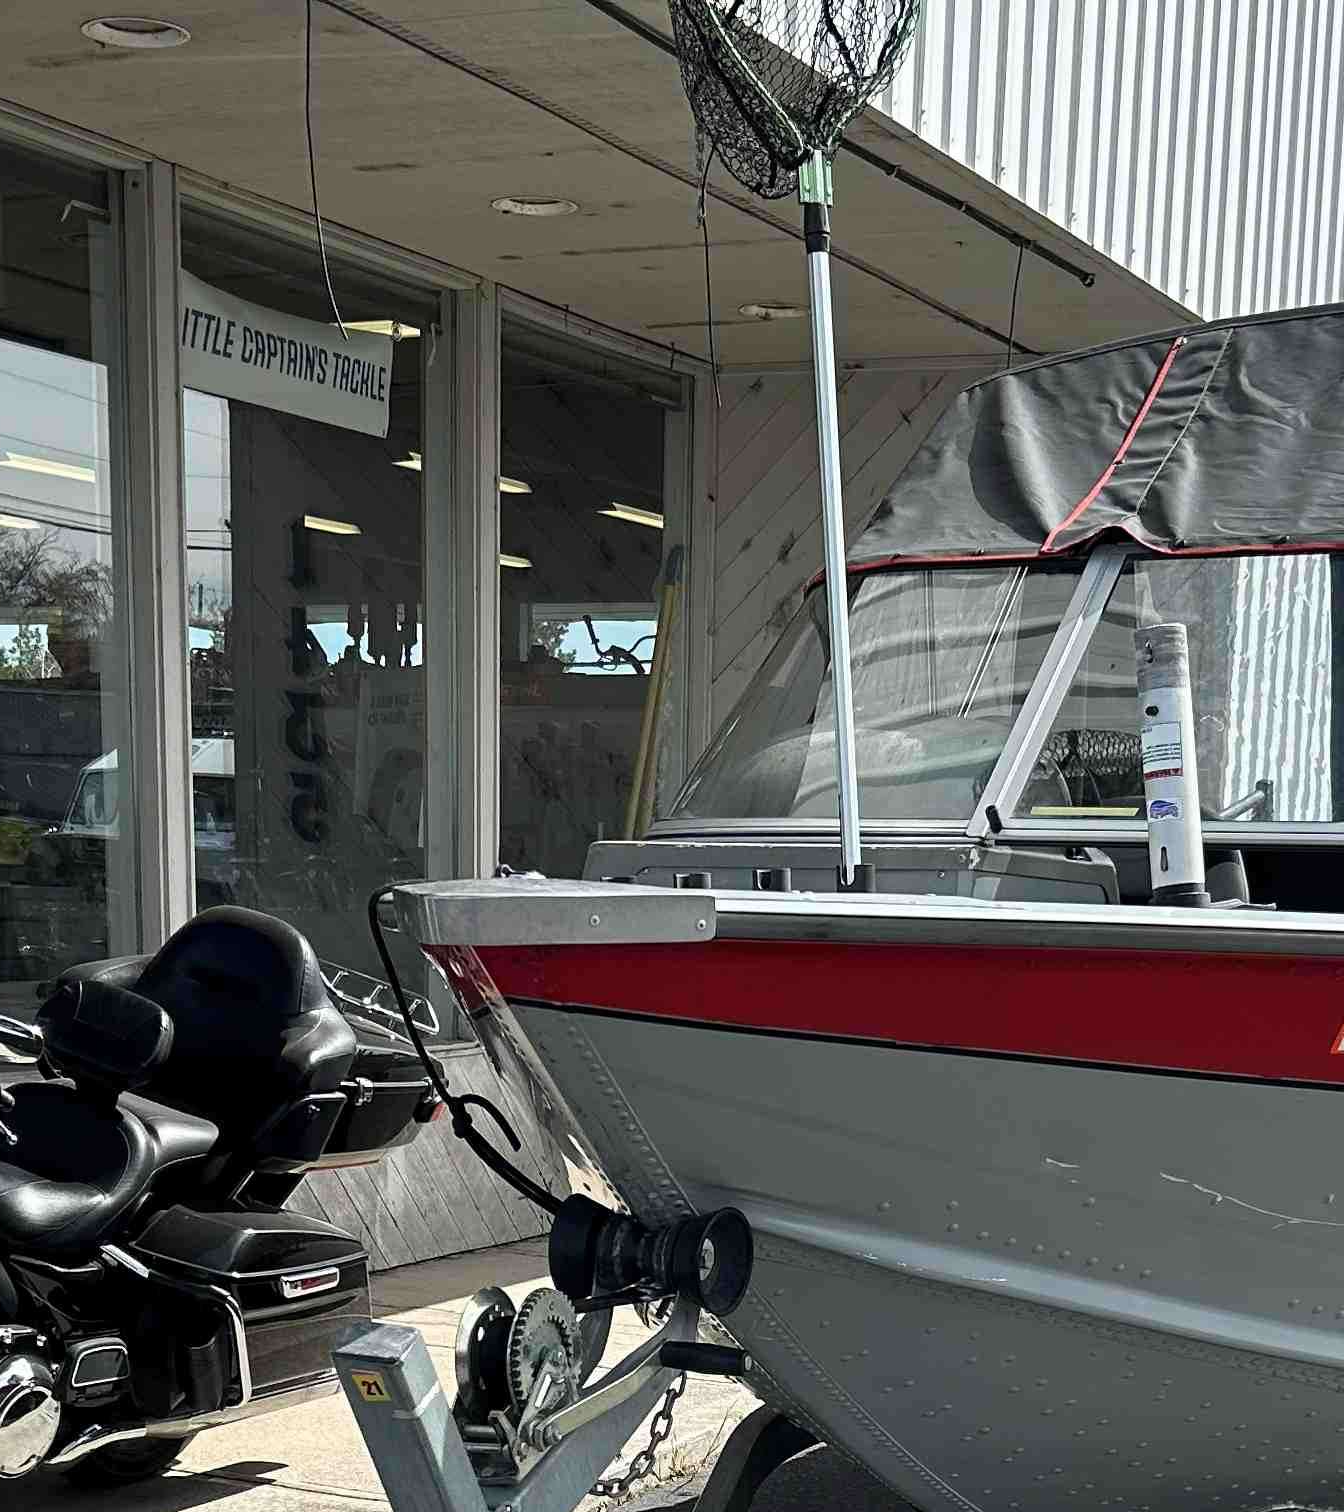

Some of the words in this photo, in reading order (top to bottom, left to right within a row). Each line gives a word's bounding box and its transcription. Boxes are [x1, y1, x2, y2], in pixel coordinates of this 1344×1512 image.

[182, 307, 236, 359] ITTLE
[241, 325, 328, 385] CAPTAIN'S
[332, 351, 388, 403] TACKLE
[362, 1380, 384, 1396] 21
